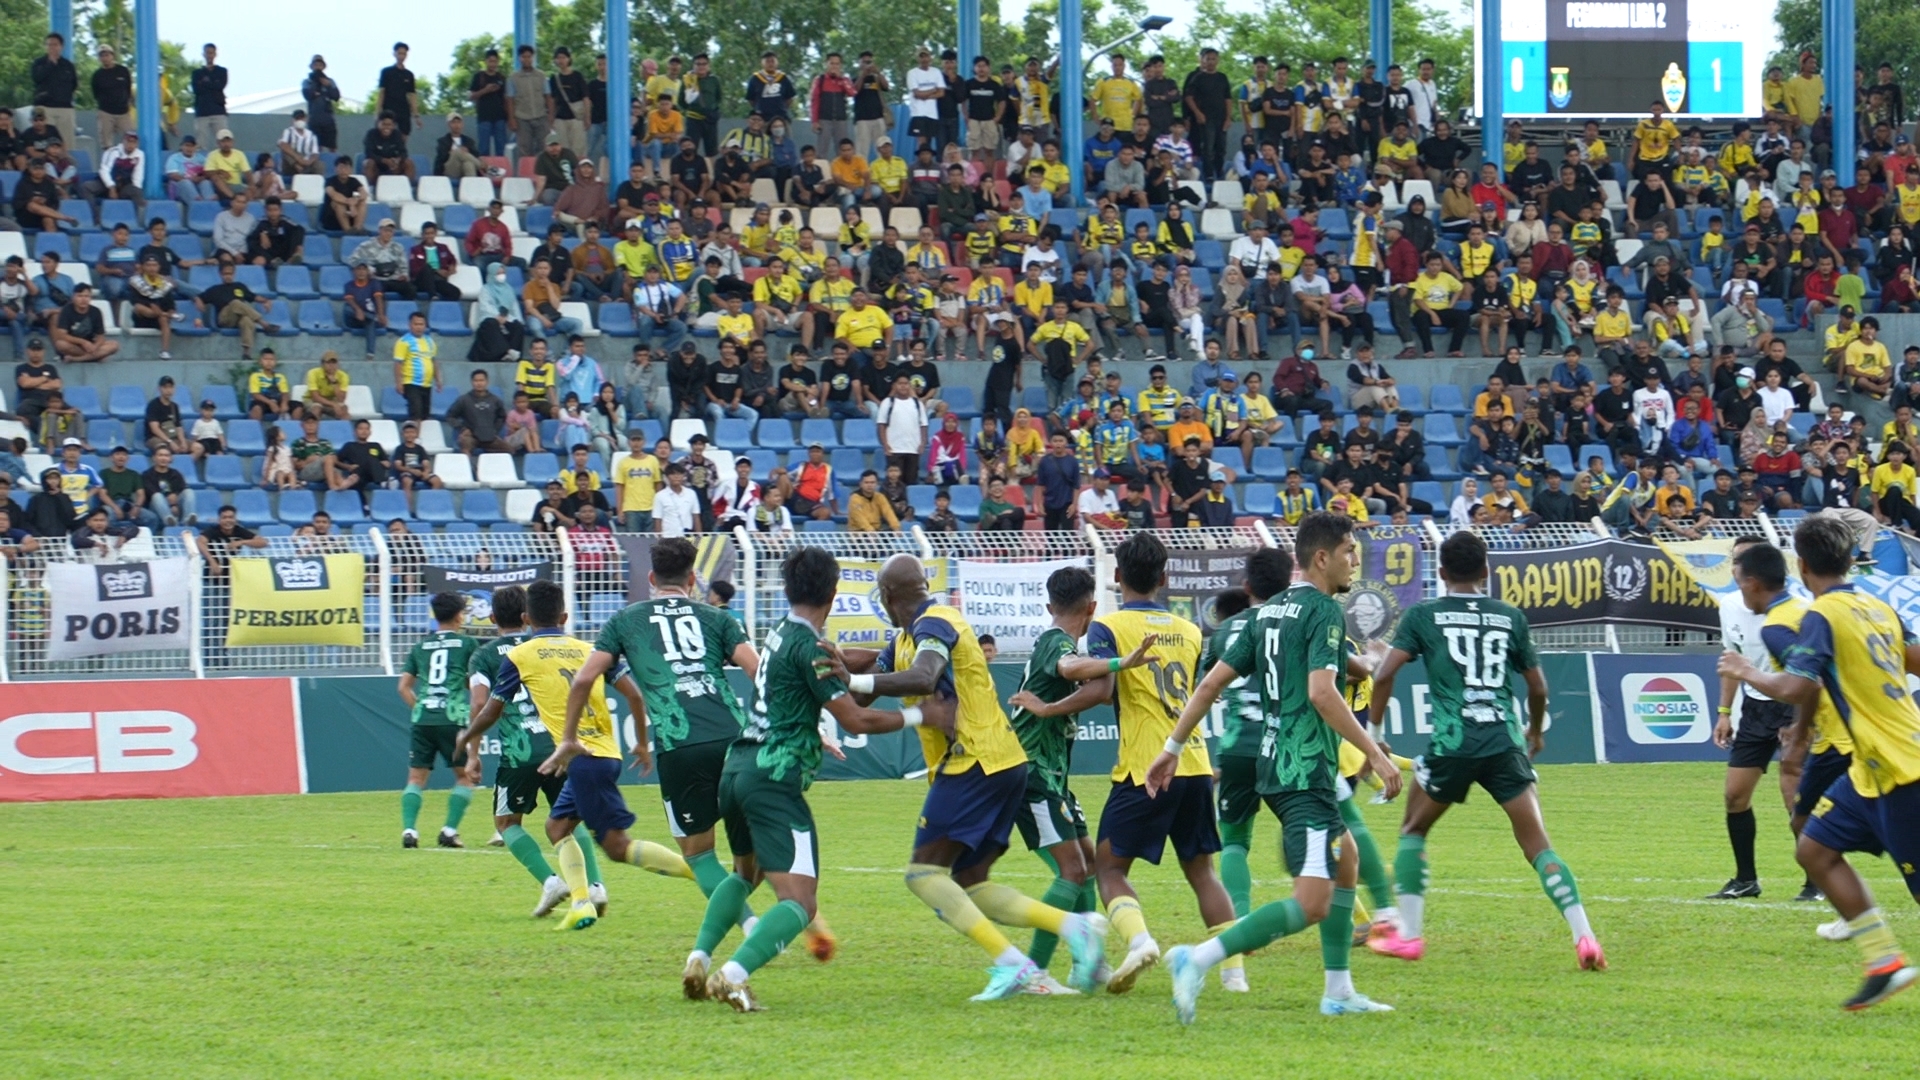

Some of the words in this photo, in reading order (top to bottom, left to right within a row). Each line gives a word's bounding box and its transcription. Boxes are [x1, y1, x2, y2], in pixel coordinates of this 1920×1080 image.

[1656, 2, 1667, 28] 2
[1510, 56, 1524, 92] 0
[1711, 57, 1722, 92] 1
[445, 568, 537, 583] PERSIKOTA
[1384, 542, 1414, 586] 9
[1613, 564, 1633, 590] 12
[964, 580, 1015, 597] FOLLOW
[1019, 581, 1045, 597] THE
[1168, 575, 1229, 590] HAPPINESS
[232, 607, 361, 627] PERSIKOTA
[835, 596, 863, 613] 19
[966, 602, 1016, 617] HEARTS
[1020, 603, 1045, 617] AND
[63, 606, 180, 642] PORIS
[838, 629, 879, 643] KAMI
[994, 625, 1027, 638] CAN'T
[649, 615, 708, 662] 10
[428, 649, 449, 685] 8
[1442, 627, 1510, 688] 48
[1632, 702, 1700, 715] INDOSIAR
[0, 709, 199, 775] CB
